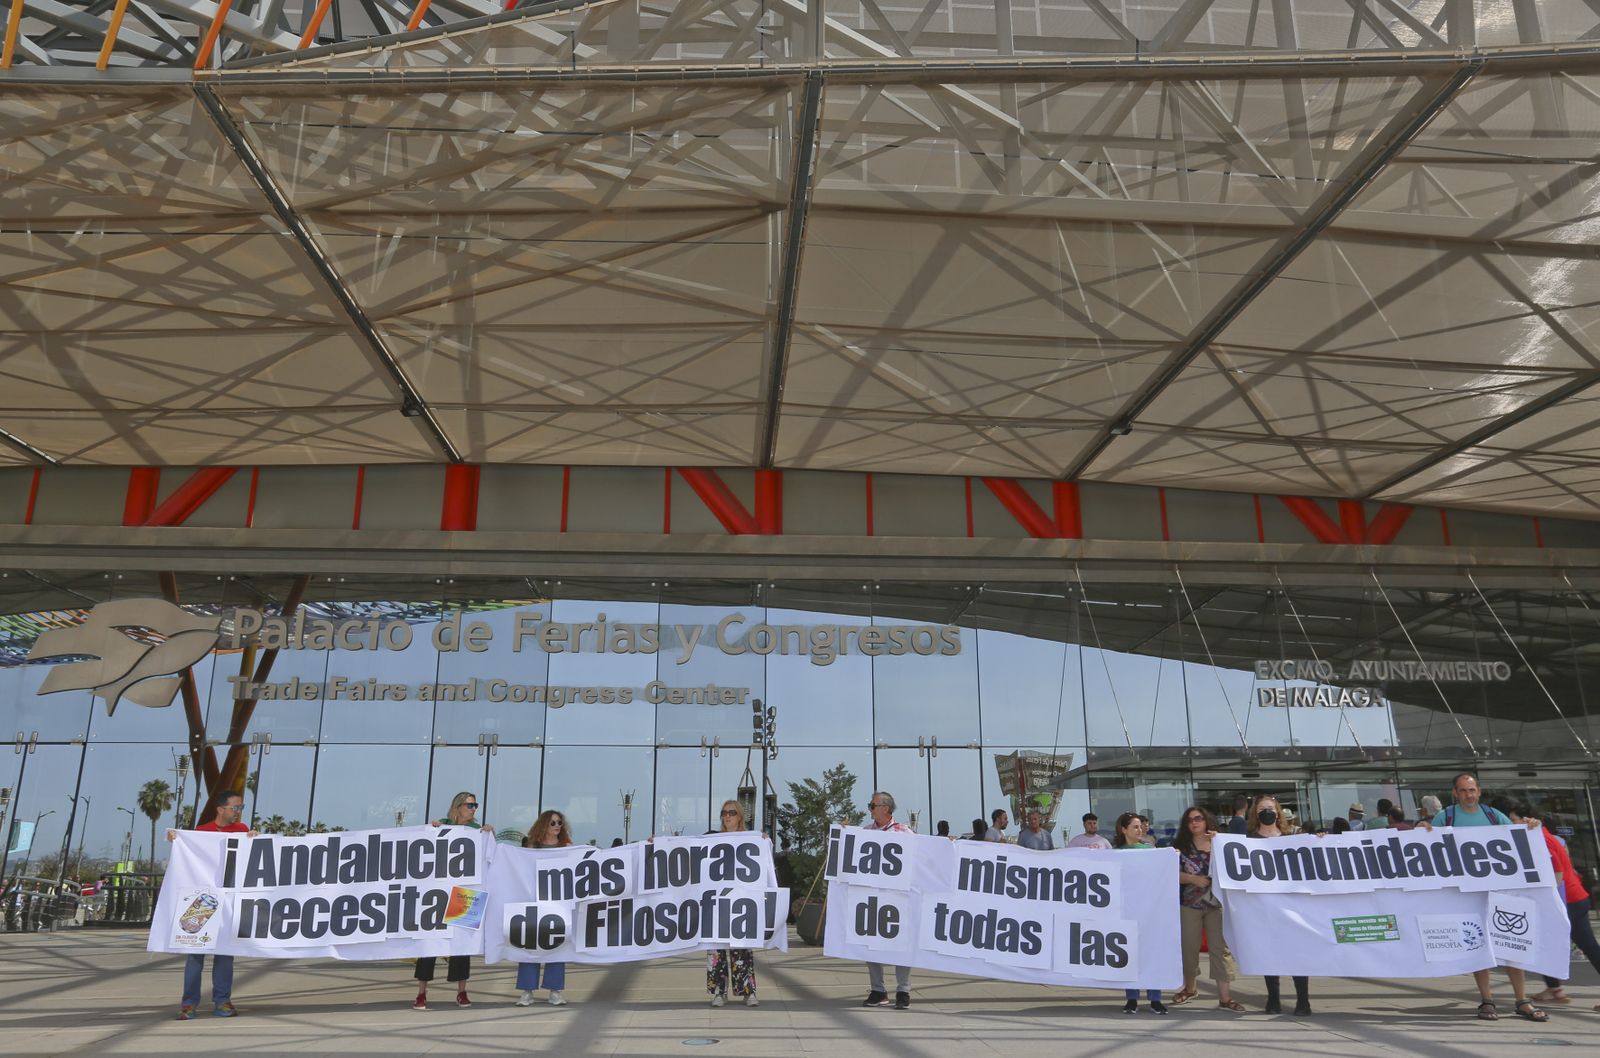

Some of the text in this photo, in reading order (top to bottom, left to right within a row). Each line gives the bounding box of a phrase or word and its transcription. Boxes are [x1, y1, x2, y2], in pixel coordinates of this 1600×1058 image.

[231, 607, 962, 666] Palacio de Ferias y Congresos
[227, 676, 750, 708] Trade Fairs and Congress Center
[1255, 660, 1511, 681] EXCMO. AYUNTAMIENTO
[1257, 687, 1287, 707] DE
[223, 829, 476, 888] ¡Andalucía
[538, 842, 760, 901] más horas
[826, 828, 903, 877] ¡Las
[1223, 828, 1541, 883] Comunidades!
[957, 855, 1111, 908] mismas
[237, 884, 448, 939] necesita
[509, 887, 777, 950] de Filosofía!
[855, 896, 1129, 969] de todas las
